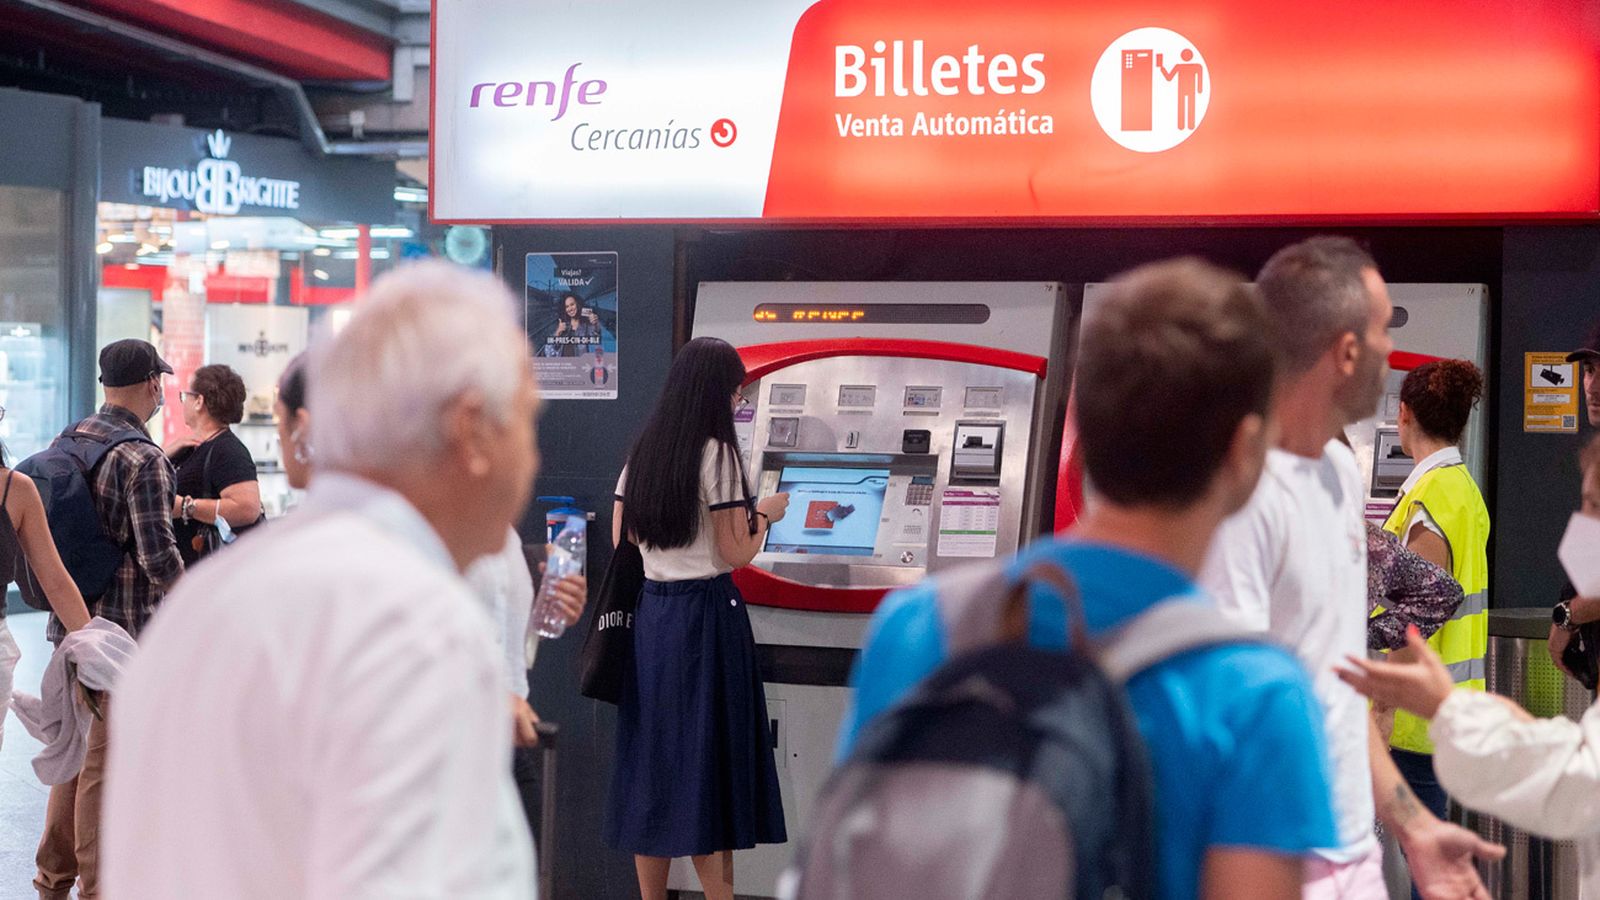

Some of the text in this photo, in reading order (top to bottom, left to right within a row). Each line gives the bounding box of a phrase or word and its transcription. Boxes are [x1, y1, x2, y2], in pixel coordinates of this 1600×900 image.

[835, 40, 1046, 97] Billetes
[469, 62, 608, 121] renfe
[571, 119, 702, 151] Cercanías
[835, 108, 1053, 137] Venta Automática
[559, 278, 585, 286] VALIDA
[598, 610, 624, 631] DIOR
